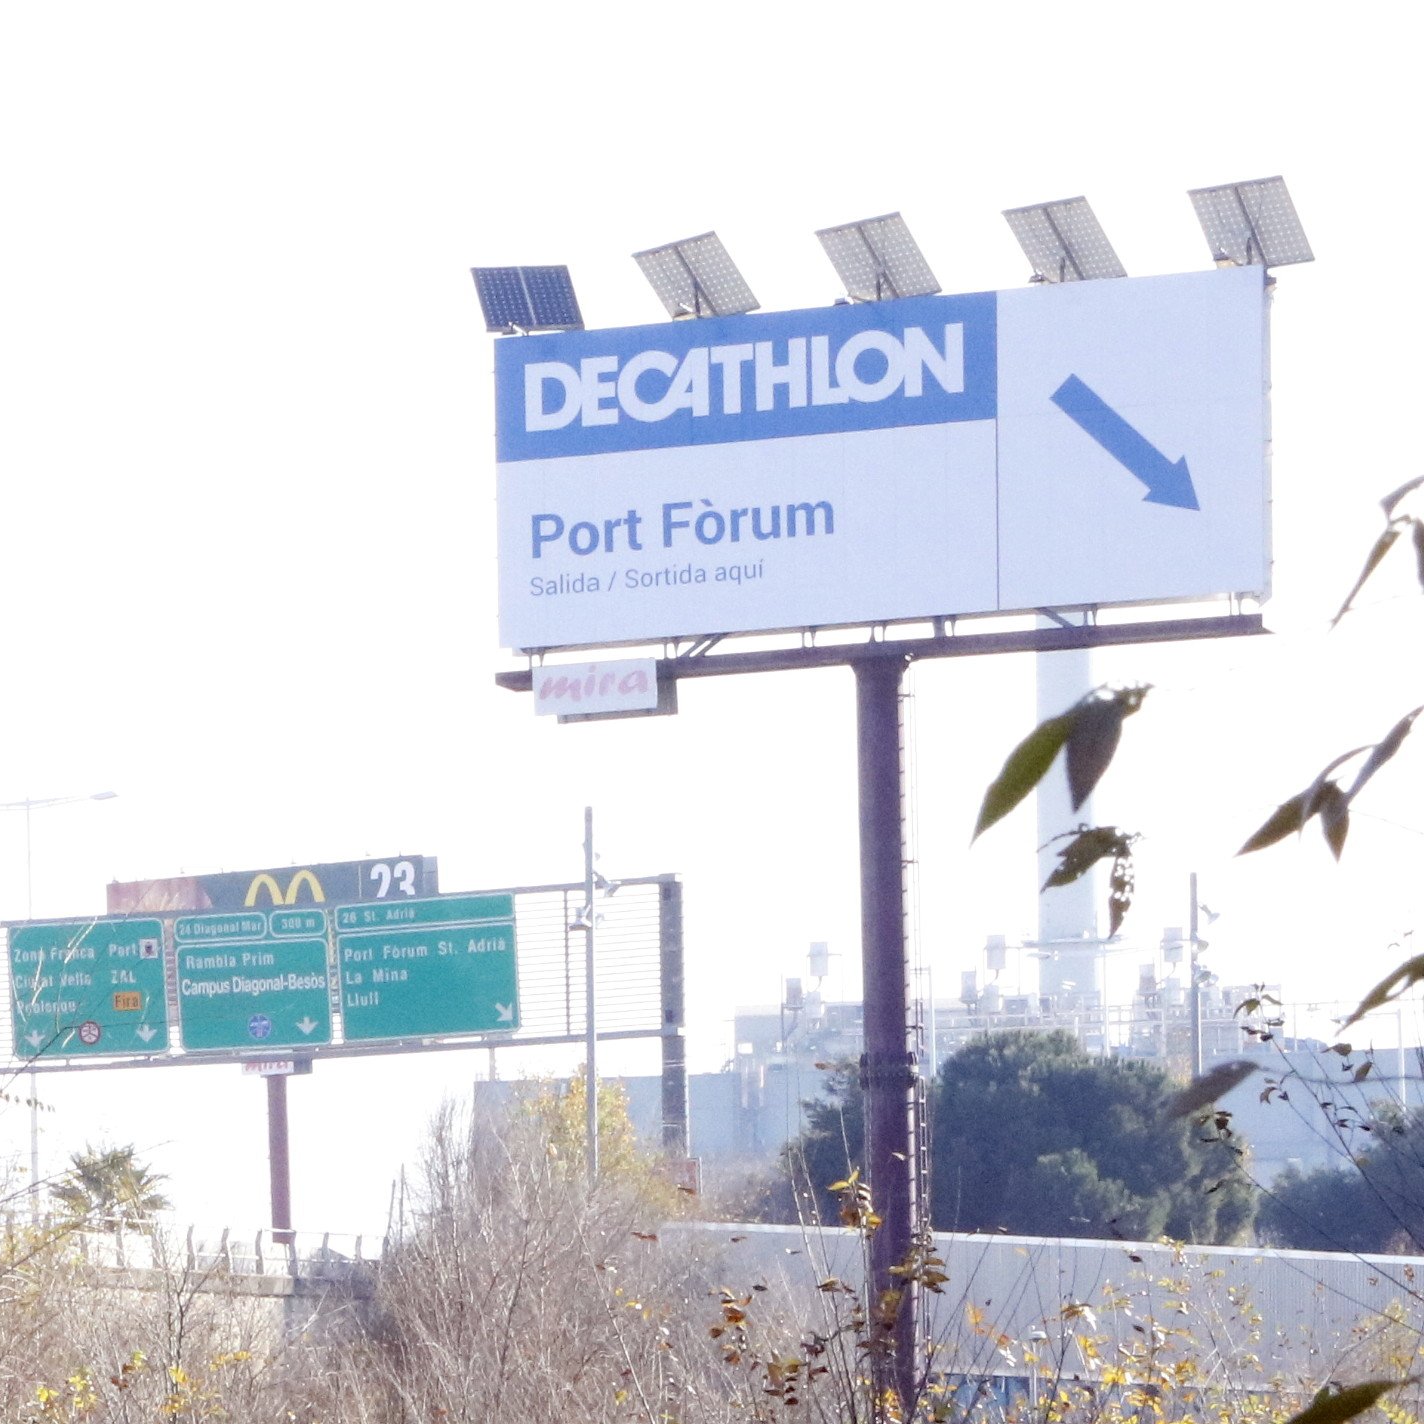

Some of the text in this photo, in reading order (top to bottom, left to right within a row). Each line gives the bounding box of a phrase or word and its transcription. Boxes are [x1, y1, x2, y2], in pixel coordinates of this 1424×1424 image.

[524, 322, 963, 432] DECATHLON
[530, 498, 835, 559] Port Fòrum
[530, 572, 600, 597] Salida
[625, 563, 706, 589] Sortida
[714, 558, 764, 585] aquí
[539, 665, 649, 702] mira
[193, 921, 240, 936] Diagonal
[242, 920, 262, 932] Mar
[108, 943, 136, 957] Port
[344, 937, 506, 962] Port Fòrum St. Adrià
[186, 952, 274, 969] Rambla Prim
[111, 970, 137, 984] ZAL
[181, 972, 325, 997] Campus Diagonal-Besòs
[346, 968, 408, 985] La Mina
[115, 994, 139, 1009] Fira
[347, 992, 379, 1007] Llull
